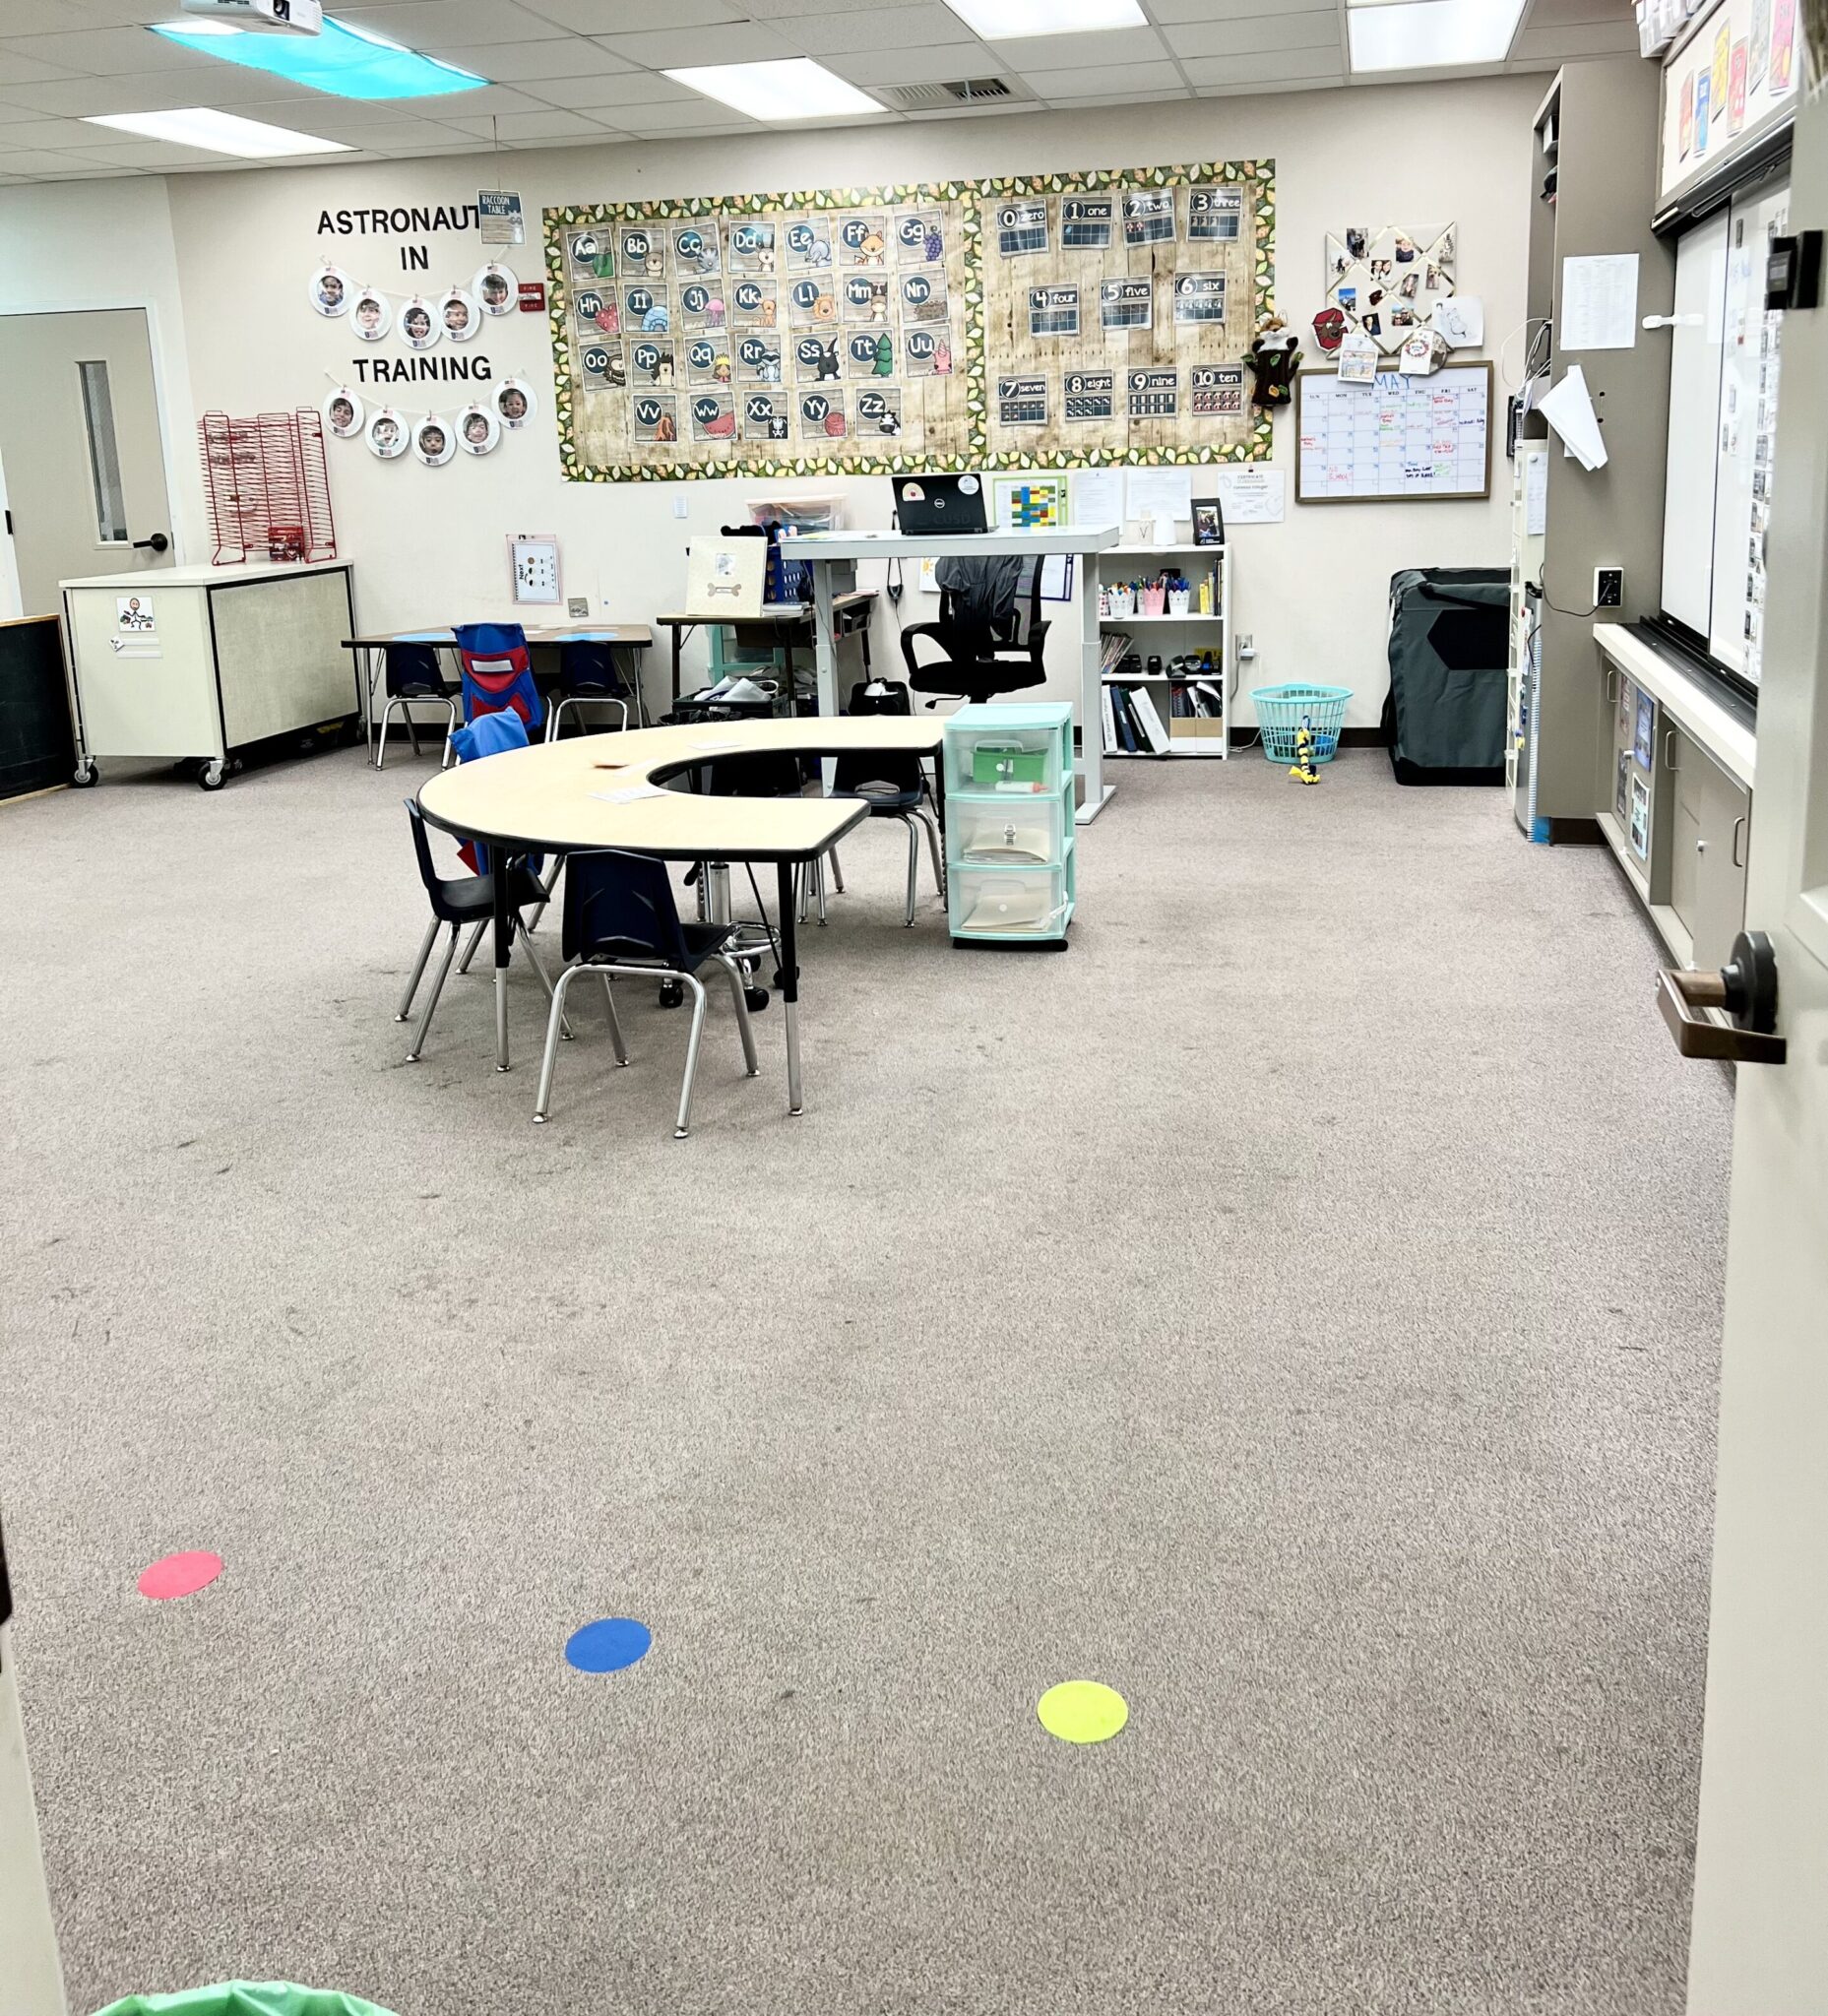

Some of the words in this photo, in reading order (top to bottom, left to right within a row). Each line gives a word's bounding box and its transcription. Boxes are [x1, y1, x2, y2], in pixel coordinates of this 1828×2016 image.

[482, 196, 510, 205] RACCOON
[1197, 194, 1208, 212] 3
[1213, 197, 1241, 208] three
[488, 205, 506, 214] TABLE
[1071, 204, 1079, 219] 1
[1088, 207, 1106, 216] one
[1131, 200, 1142, 218] 2
[1147, 200, 1169, 211] two
[1004, 211, 1016, 226] 0
[1020, 210, 1044, 222] zero
[736, 232, 756, 246] Dd
[789, 229, 811, 245] Ee
[848, 225, 865, 239] Ff
[901, 222, 923, 242] Gg
[575, 240, 596, 255] Aa
[628, 237, 647, 253] Bb
[678, 236, 700, 252] Cc
[400, 246, 429, 271] IN
[797, 285, 813, 301] Ll
[849, 284, 872, 299] Mm
[906, 284, 927, 298] Nn
[1107, 284, 1118, 300] 5
[1124, 285, 1148, 296] five
[1183, 278, 1193, 293] 6
[1203, 282, 1219, 291] six
[690, 290, 703, 310] Jj
[739, 288, 760, 303] Kk
[1034, 290, 1047, 307] 4
[1053, 293, 1075, 304] four
[579, 297, 600, 313] Hh
[744, 343, 762, 358] Rr
[800, 343, 820, 357] Ss
[854, 340, 873, 355] Tt
[910, 337, 932, 352] Uu
[585, 354, 608, 368] Oo
[638, 349, 657, 368] Pp
[690, 346, 712, 364] Qq
[352, 355, 492, 383] TRAINING
[1071, 376, 1083, 393] 8
[1087, 378, 1111, 390] eight
[1134, 374, 1146, 392] 9
[1152, 376, 1175, 386] nine
[1196, 371, 1213, 386] 10
[1219, 374, 1238, 383] ten
[1004, 382, 1016, 398] 7
[638, 405, 661, 419] Vv
[695, 406, 719, 416] Ww
[749, 402, 772, 416] Xx
[806, 400, 827, 419] Yy
[861, 398, 884, 413] Zz
